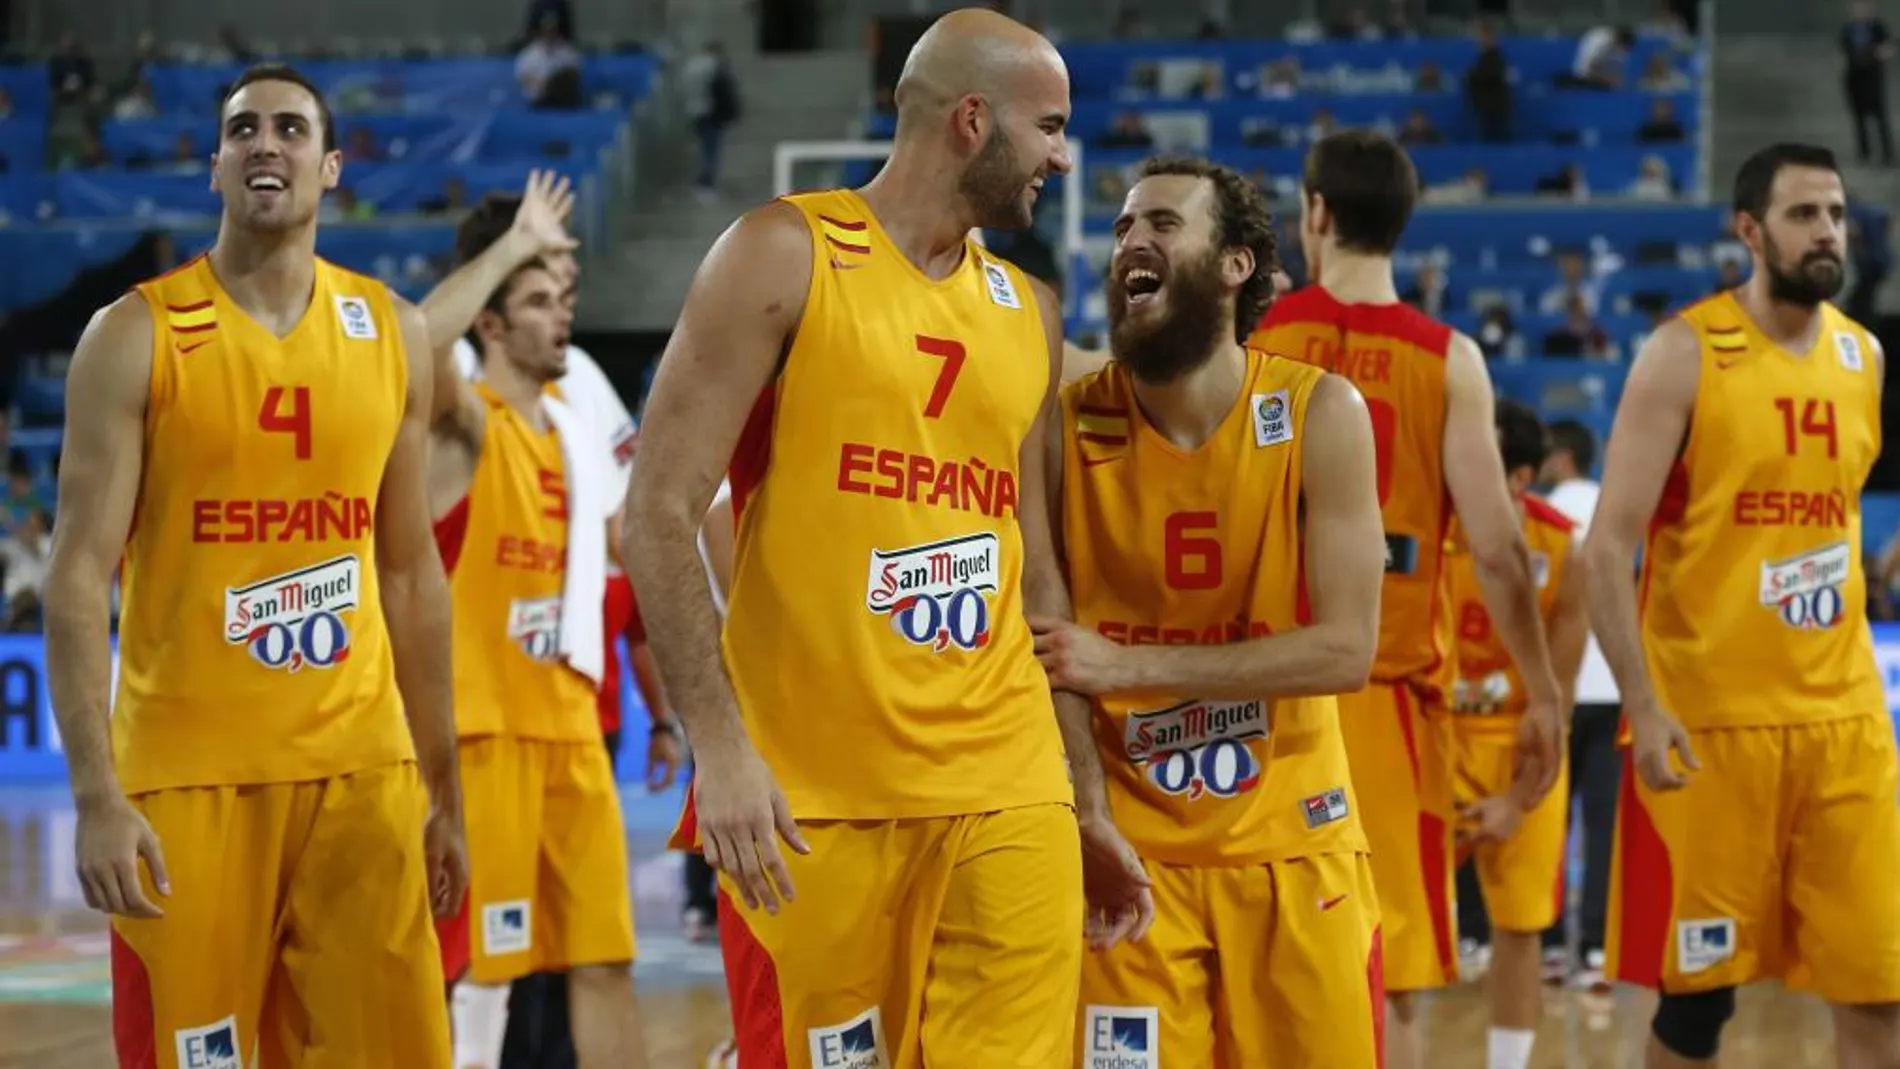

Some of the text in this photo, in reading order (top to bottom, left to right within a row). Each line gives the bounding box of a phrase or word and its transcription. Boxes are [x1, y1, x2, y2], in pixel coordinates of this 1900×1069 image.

[915, 334, 966, 419] 7
[258, 386, 312, 460] 4
[1775, 398, 1838, 460] 14
[193, 490, 372, 543] ESPAÑA
[838, 443, 1018, 519] ESPAÑA
[497, 535, 568, 574] ESP
[1165, 511, 1222, 589] 6
